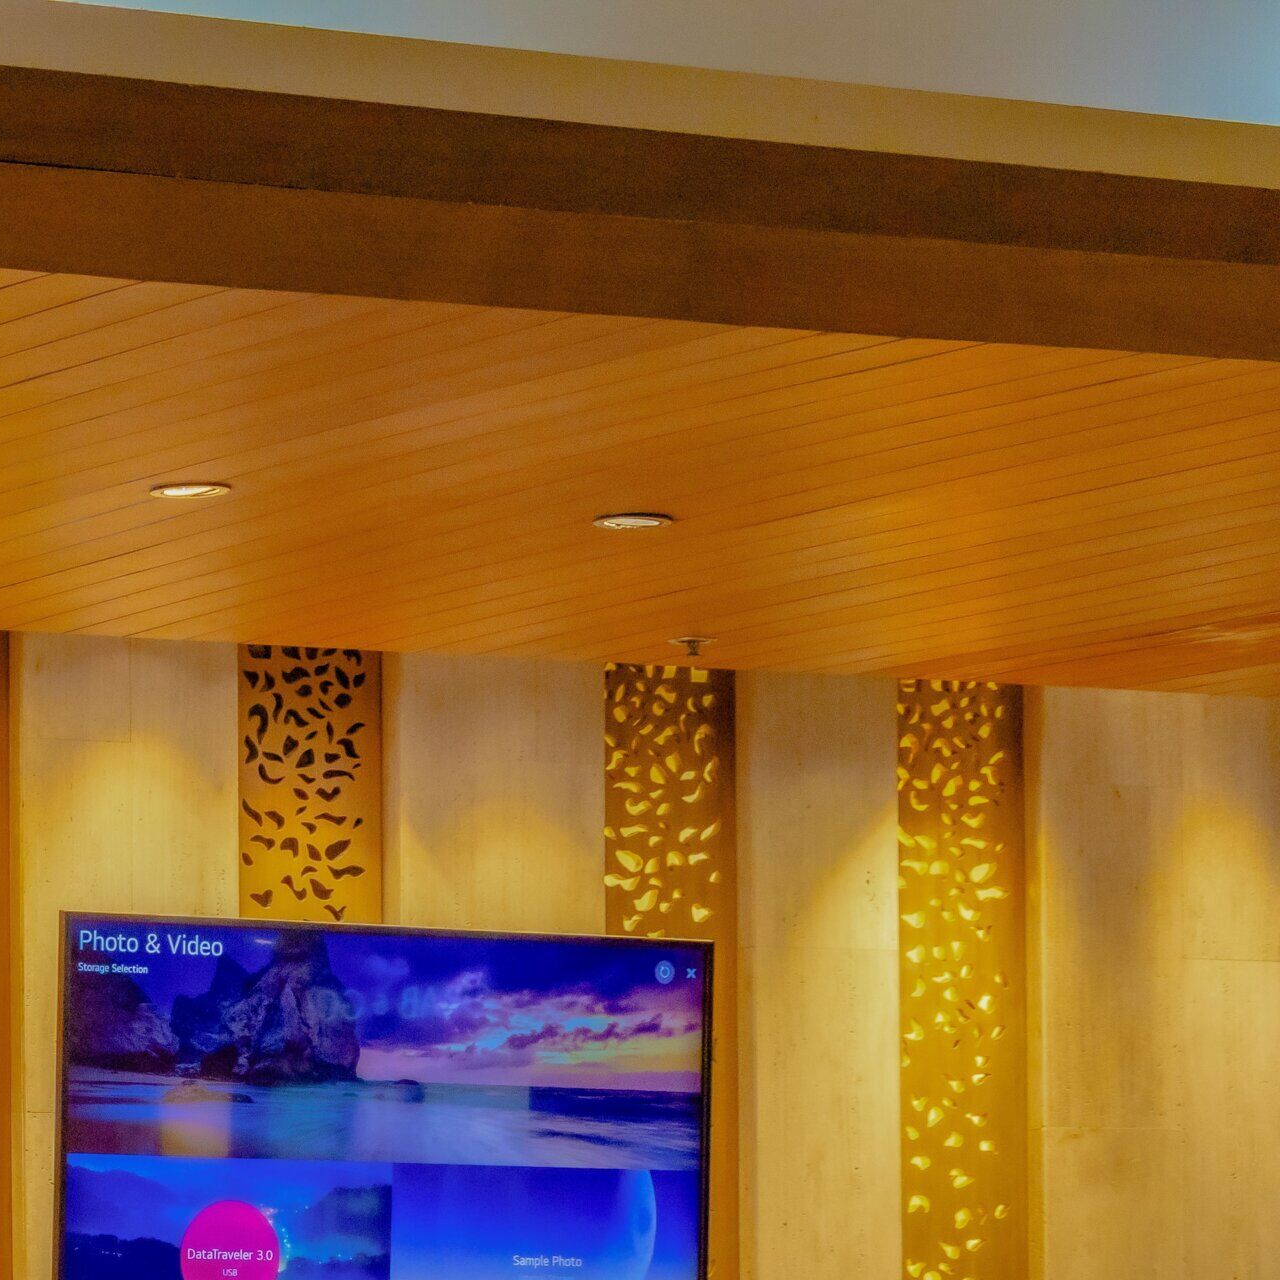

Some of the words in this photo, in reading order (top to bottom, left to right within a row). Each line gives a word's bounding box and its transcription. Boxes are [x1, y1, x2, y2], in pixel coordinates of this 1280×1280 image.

[78, 929, 139, 953] Photo
[145, 933, 161, 955] &
[167, 934, 224, 957] Video
[77, 962, 110, 975] Storage
[111, 963, 149, 975] Selection
[186, 1247, 254, 1261] DataTraveler
[256, 1249, 274, 1261] 3.0
[512, 1254, 550, 1269] Sample
[552, 1255, 583, 1268] Photo
[222, 1268, 238, 1277] USB
